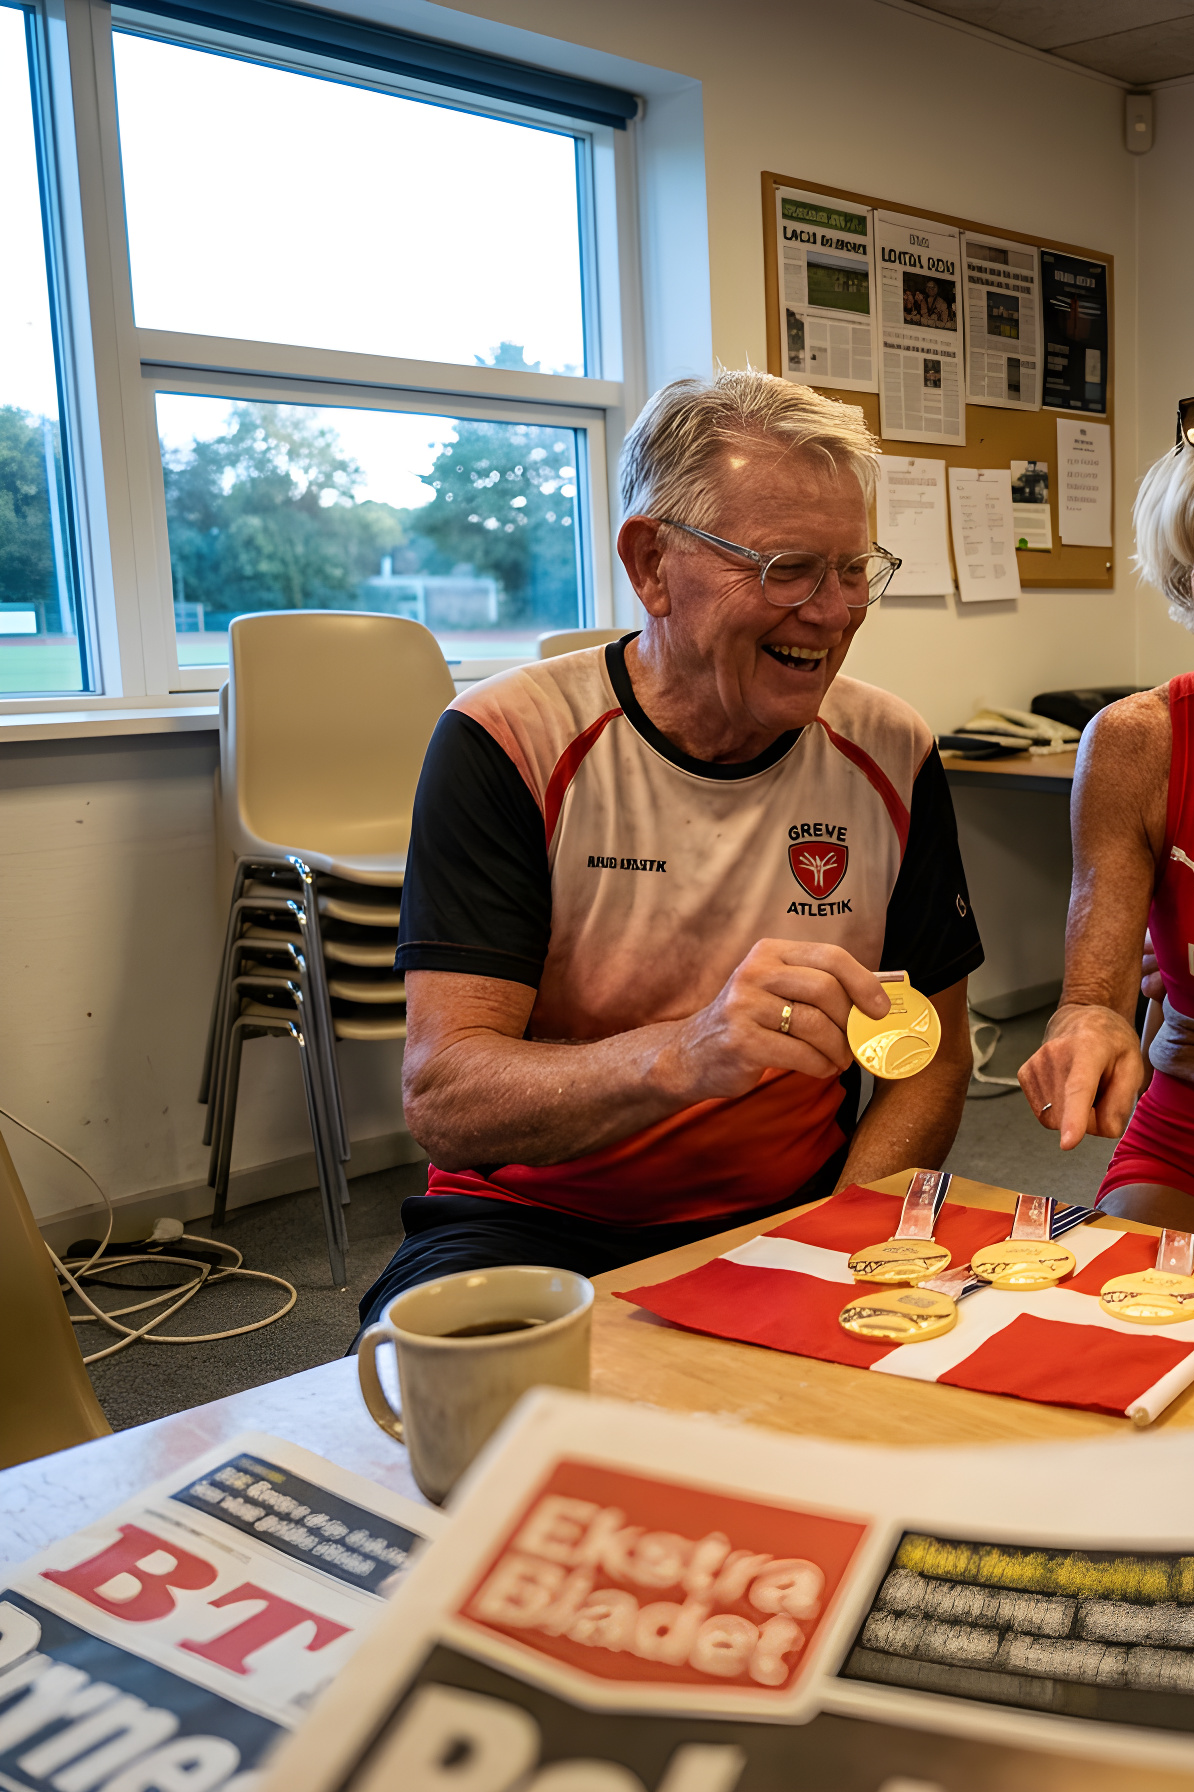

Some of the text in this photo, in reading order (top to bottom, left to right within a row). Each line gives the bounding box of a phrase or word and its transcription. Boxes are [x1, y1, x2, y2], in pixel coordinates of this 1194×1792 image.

[788, 823, 848, 842] GREVE
[787, 898, 853, 917] ATLETIK
[38, 1523, 355, 1676] BT
